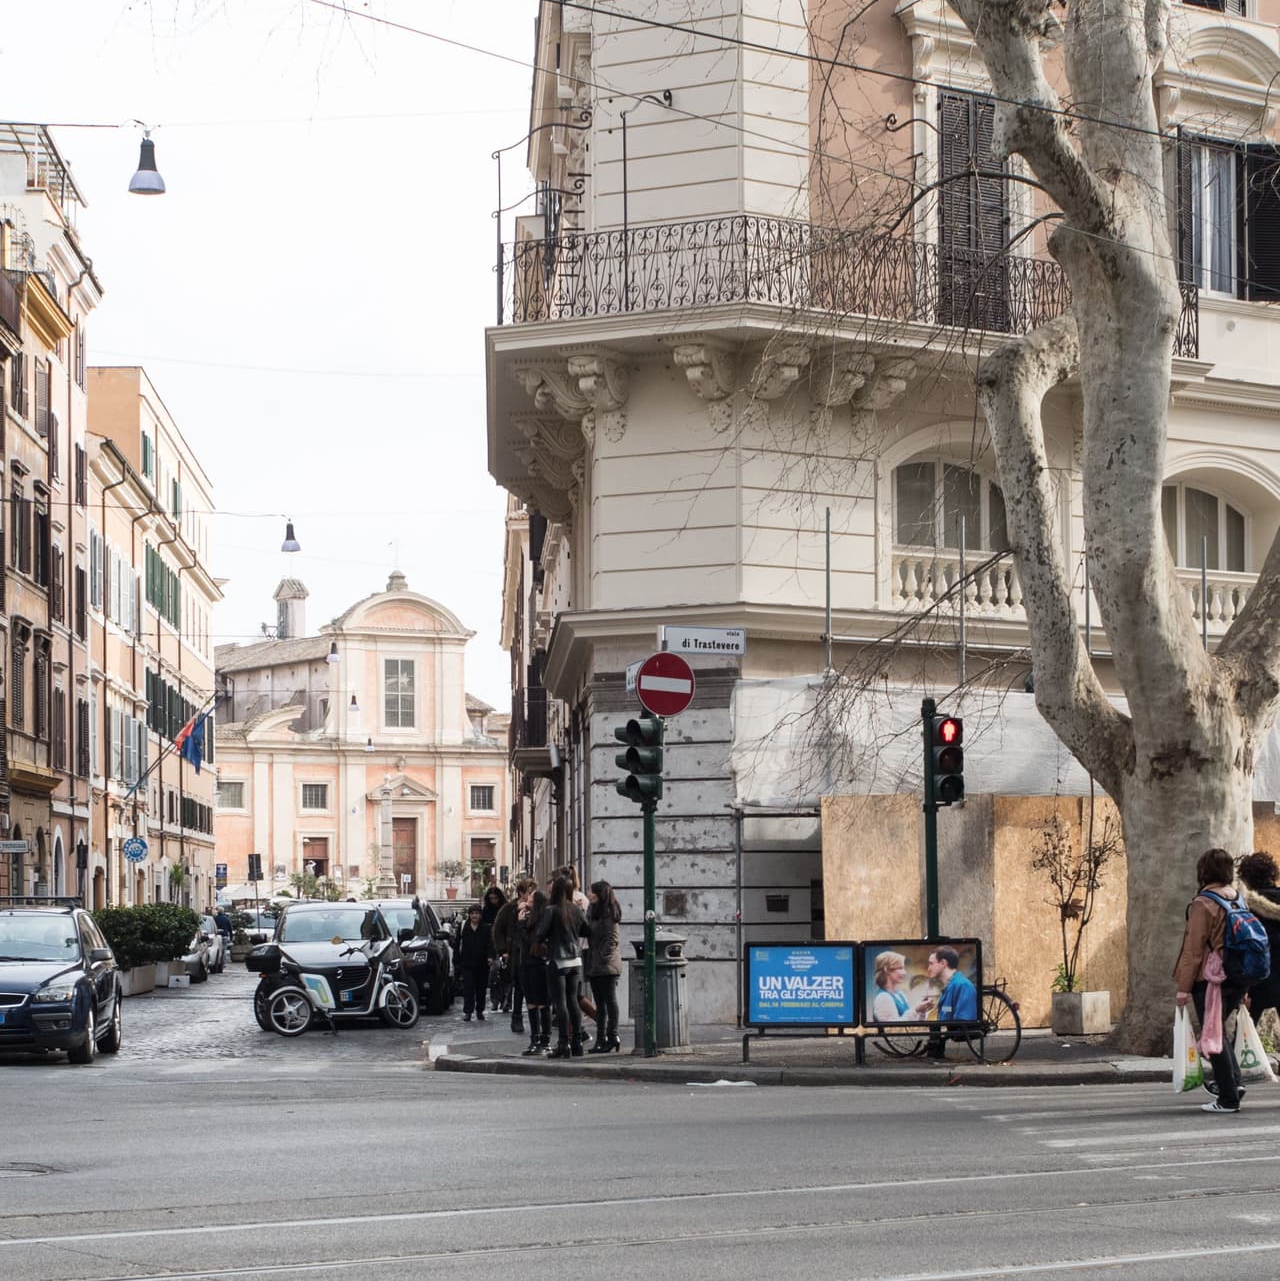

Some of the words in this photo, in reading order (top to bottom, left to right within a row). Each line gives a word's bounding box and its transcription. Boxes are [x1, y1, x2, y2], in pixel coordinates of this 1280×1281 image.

[682, 638, 690, 649] di
[694, 639, 740, 651] Trastevere
[759, 976, 782, 990] UN
[783, 976, 844, 990] VALZER
[759, 990, 779, 999] TRA
[780, 990, 796, 999] GLI
[797, 990, 844, 999] SCAFFALI
